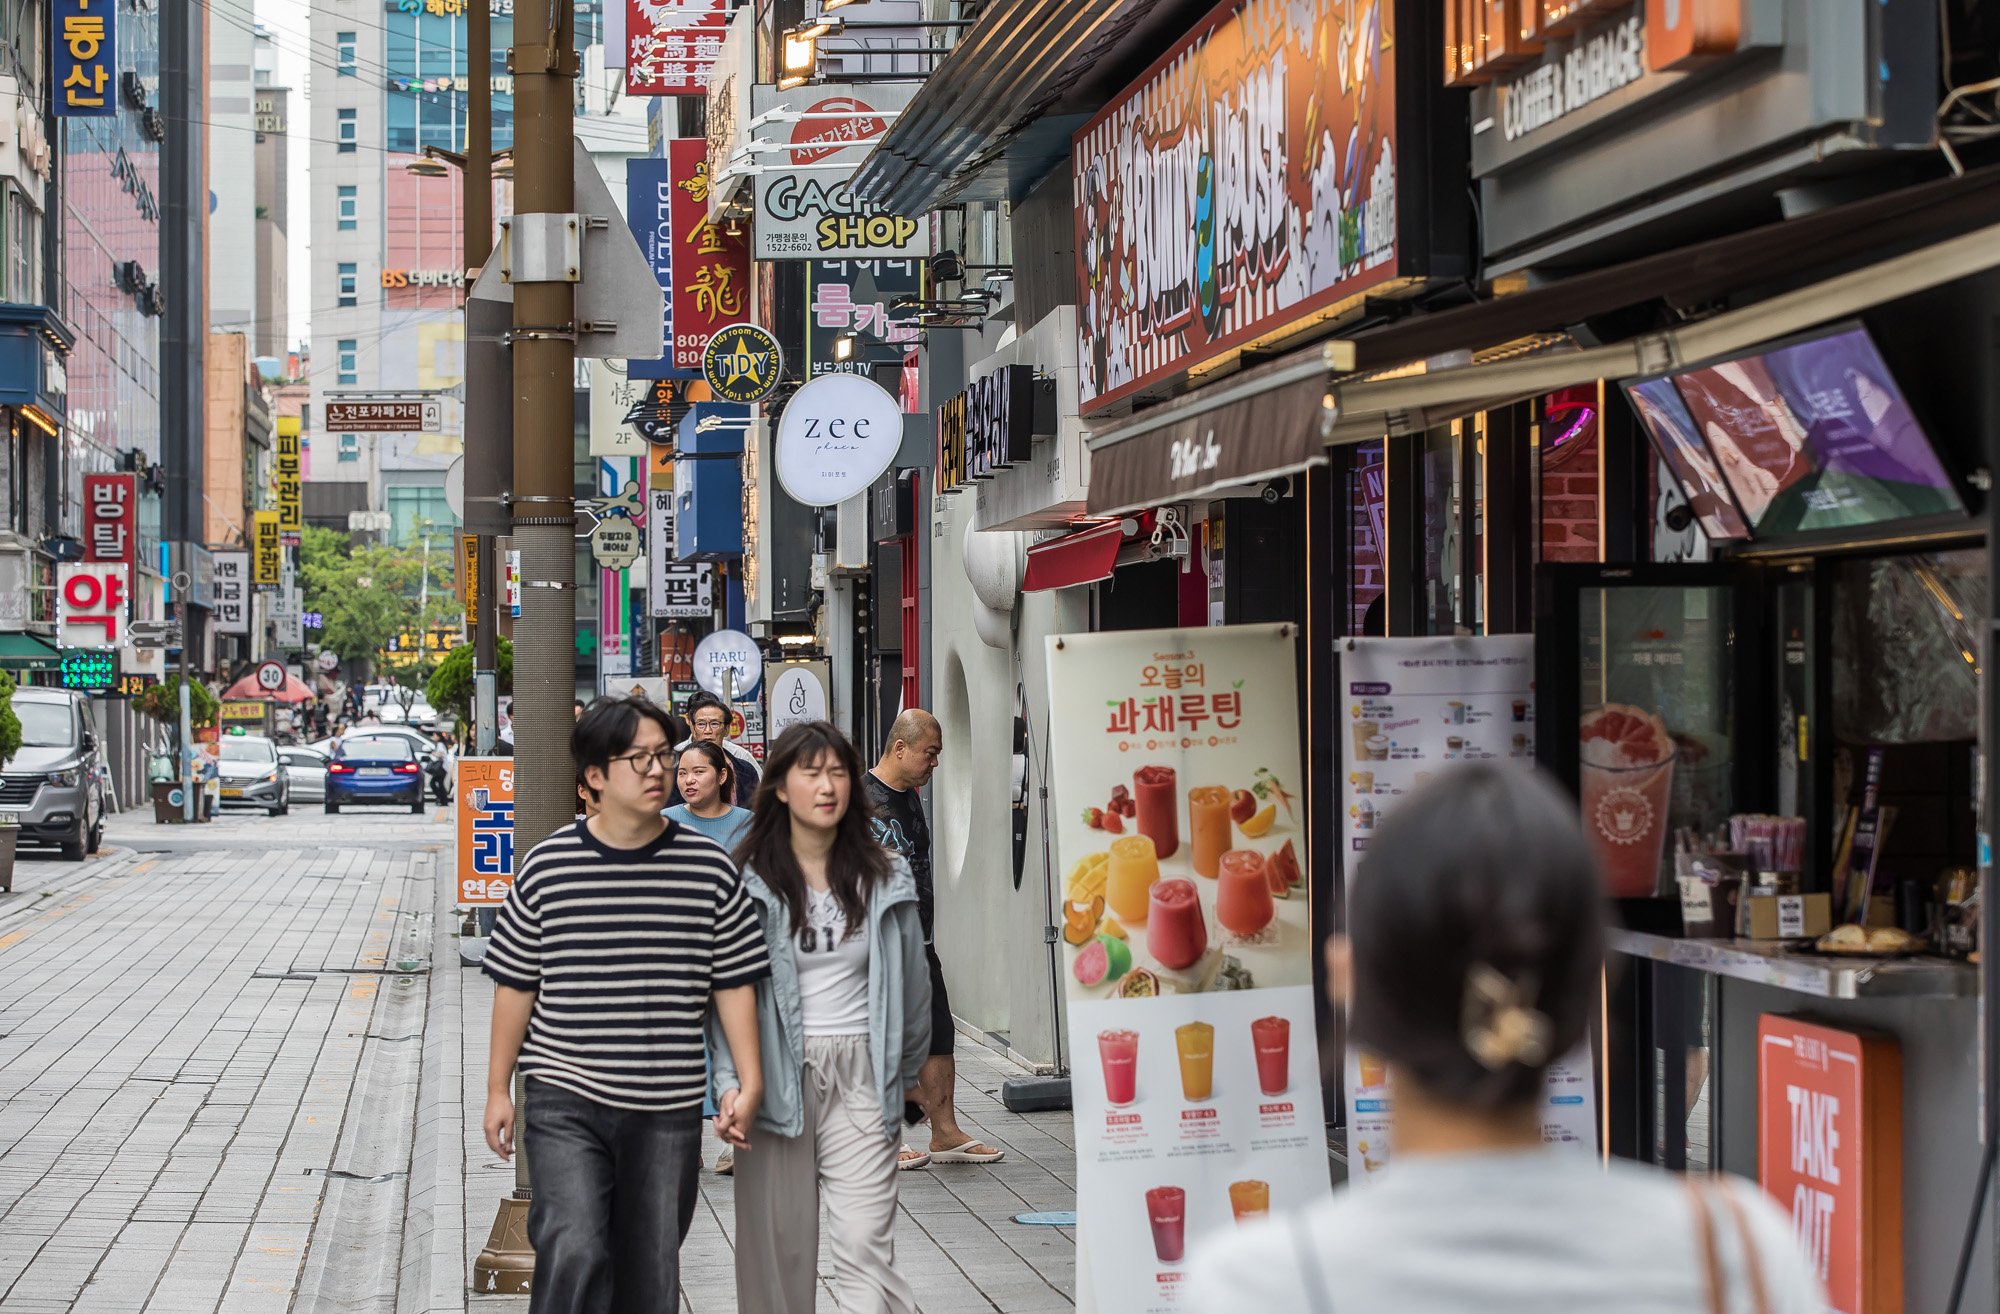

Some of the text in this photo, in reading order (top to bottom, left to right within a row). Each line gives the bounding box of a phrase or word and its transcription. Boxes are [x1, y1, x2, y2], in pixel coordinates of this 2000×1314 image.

[63, 0, 109, 107] 동산
[1504, 63, 1553, 142] COFFEE
[1565, 15, 1644, 113] BEVERAGE
[1134, 122, 1202, 322] BUNNY
[1213, 46, 1288, 268] HOUSE
[766, 233, 808, 243] 가맹점문의
[816, 215, 918, 251] SHOP
[766, 243, 812, 252] 1522-6602
[381, 270, 408, 288] BS
[686, 213, 746, 324] 金龍
[812, 284, 920, 352] 룸카페
[706, 328, 779, 401] Tidy room cafe Tidy room cafe Tidy room cafe
[715, 352, 769, 377] TIDY
[812, 361, 871, 376] 보드게임 TV
[345, 405, 420, 419] 전포카페거리
[615, 433, 632, 444] 2F
[804, 418, 870, 439] zee
[278, 435, 300, 525] 피부관리
[94, 484, 127, 557] 방탈
[260, 523, 279, 580] 피부관리
[603, 543, 629, 552] 헤어샵
[64, 574, 123, 640] 약
[709, 651, 747, 663] HARU
[263, 669, 280, 683] 30
[1139, 662, 1205, 690] 오늘의
[1106, 691, 1242, 735] 과채루틴
[464, 764, 496, 782] 코인
[462, 879, 513, 900] 연습
[800, 926, 834, 953] 01
[1787, 1084, 1840, 1187] TAKE
[1792, 1182, 1836, 1281] OUT
